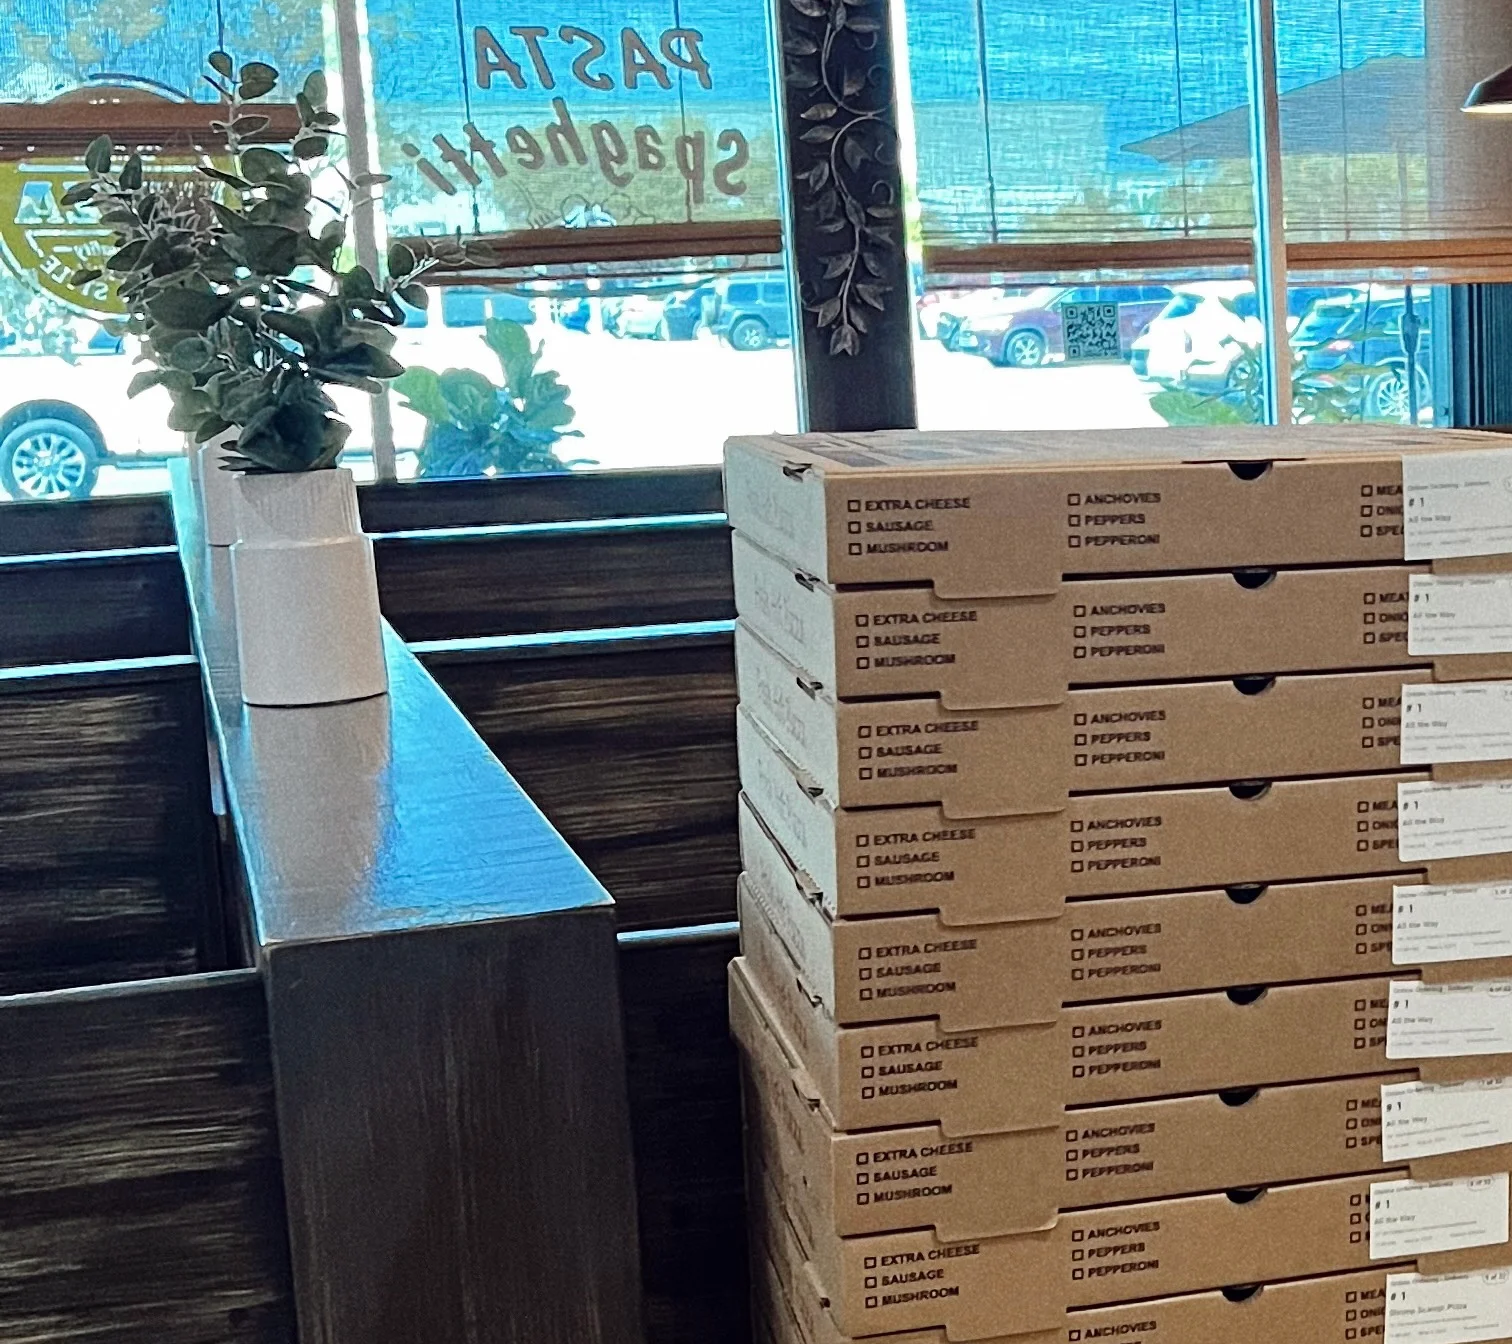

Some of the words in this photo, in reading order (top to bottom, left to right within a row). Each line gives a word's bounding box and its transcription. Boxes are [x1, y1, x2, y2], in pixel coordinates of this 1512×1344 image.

[865, 500, 914, 511] EXTRA
[915, 497, 970, 510] CHEESE
[1084, 492, 1161, 505] ANCHOVIES
[866, 520, 936, 533] SAUSAGE
[1085, 513, 1145, 526] PEPPERS
[1084, 534, 1160, 546] PEPPERONI
[866, 541, 948, 554] MUSHROOM
[1089, 603, 1165, 616] ANCHOVIES
[873, 614, 920, 626] EXTRA
[922, 612, 977, 623] CHEESE
[1090, 624, 1151, 637] PEPPERS
[874, 633, 941, 646] SAUSAGE
[1090, 644, 1165, 657] PEPPERONI
[874, 654, 955, 667] MUSHROOM
[1087, 816, 1162, 831] ANCHOVIES
[874, 833, 919, 846] EXTRA
[922, 830, 975, 842] CHEESE
[1086, 837, 1147, 851] PEPPERS
[874, 851, 940, 867] SAUSAGE
[1087, 856, 1161, 871] PEPPERONI
[874, 871, 955, 886] MUSHROOM
[1088, 1020, 1162, 1036] ANCHOVIES
[878, 1042, 922, 1057] EXTRA
[926, 1038, 978, 1052] CHEESE
[1088, 1041, 1147, 1056] PEPPERS
[878, 1061, 943, 1080] SAUSAGE
[1088, 1059, 1161, 1076] PEPPERONI
[879, 1079, 958, 1096] MUSHROOM
[1084, 1321, 1157, 1339] ANCHOVIES
